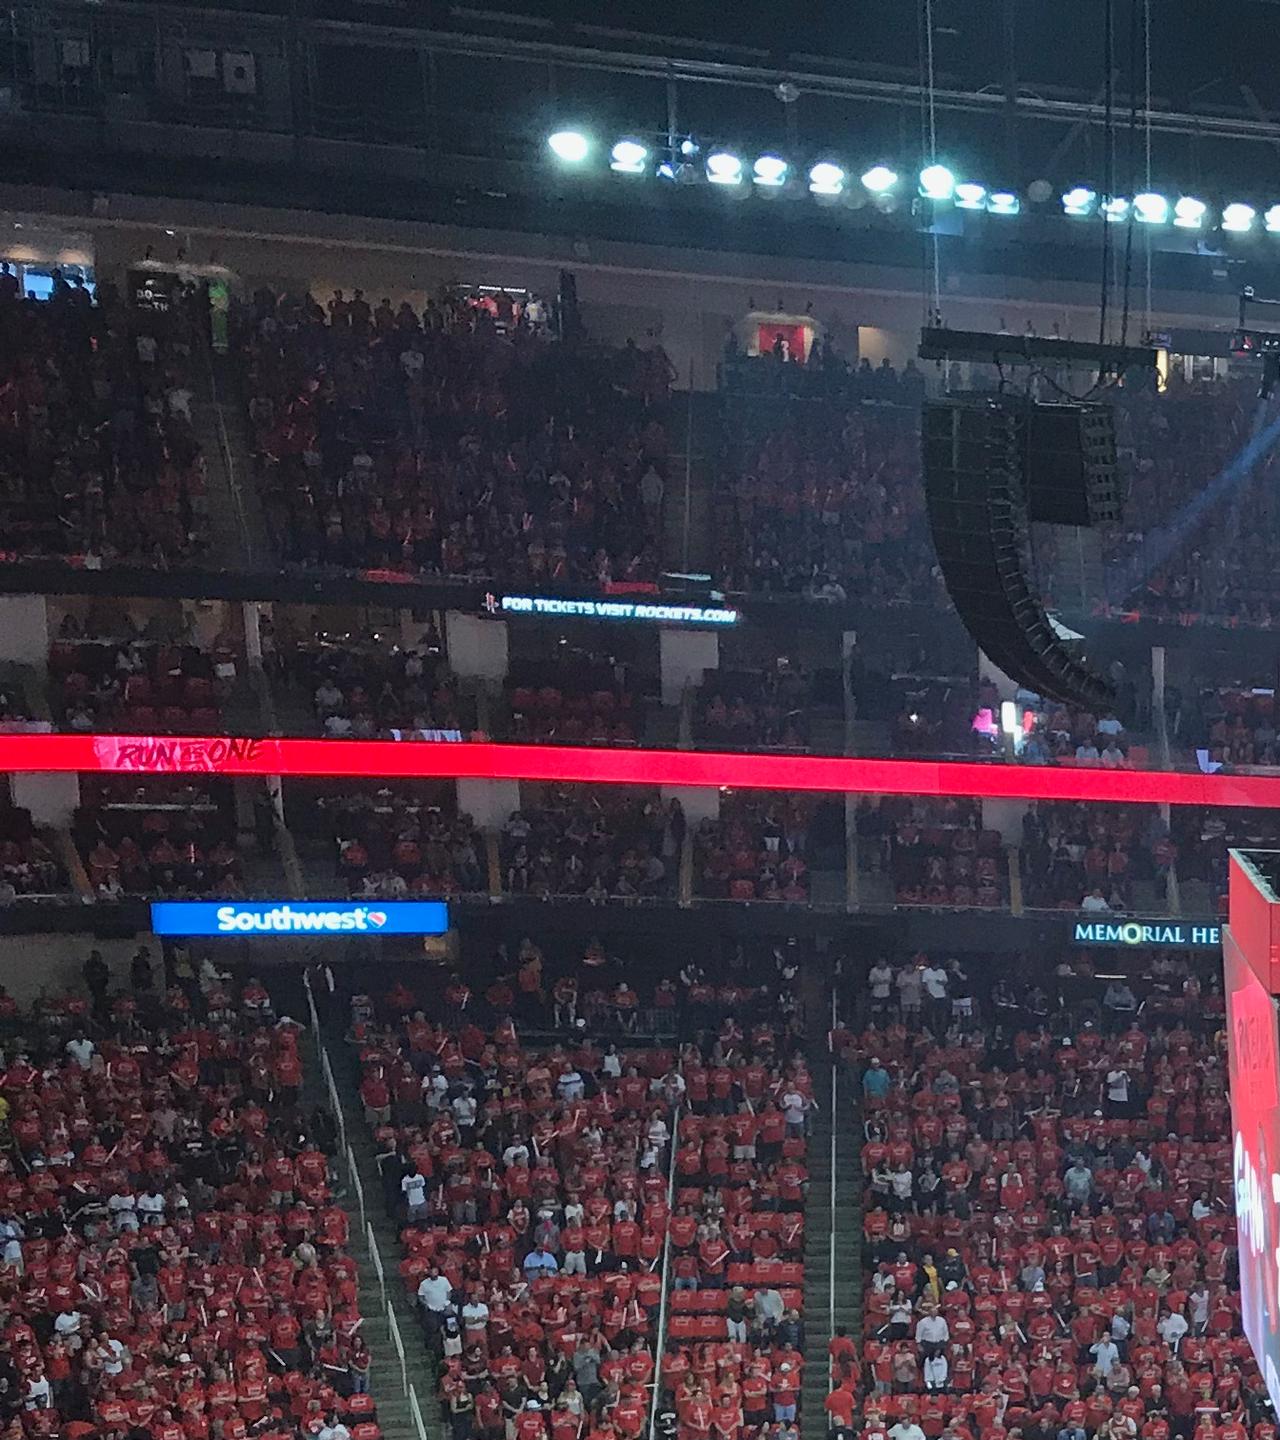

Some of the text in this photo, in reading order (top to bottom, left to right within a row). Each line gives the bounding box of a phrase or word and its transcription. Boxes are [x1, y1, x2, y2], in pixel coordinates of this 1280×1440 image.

[501, 596, 737, 623] FOR TICKETS VISIT ROCKETS.COM
[217, 906, 367, 931] Southwest
[1075, 923, 1185, 944] MEMORIAL
